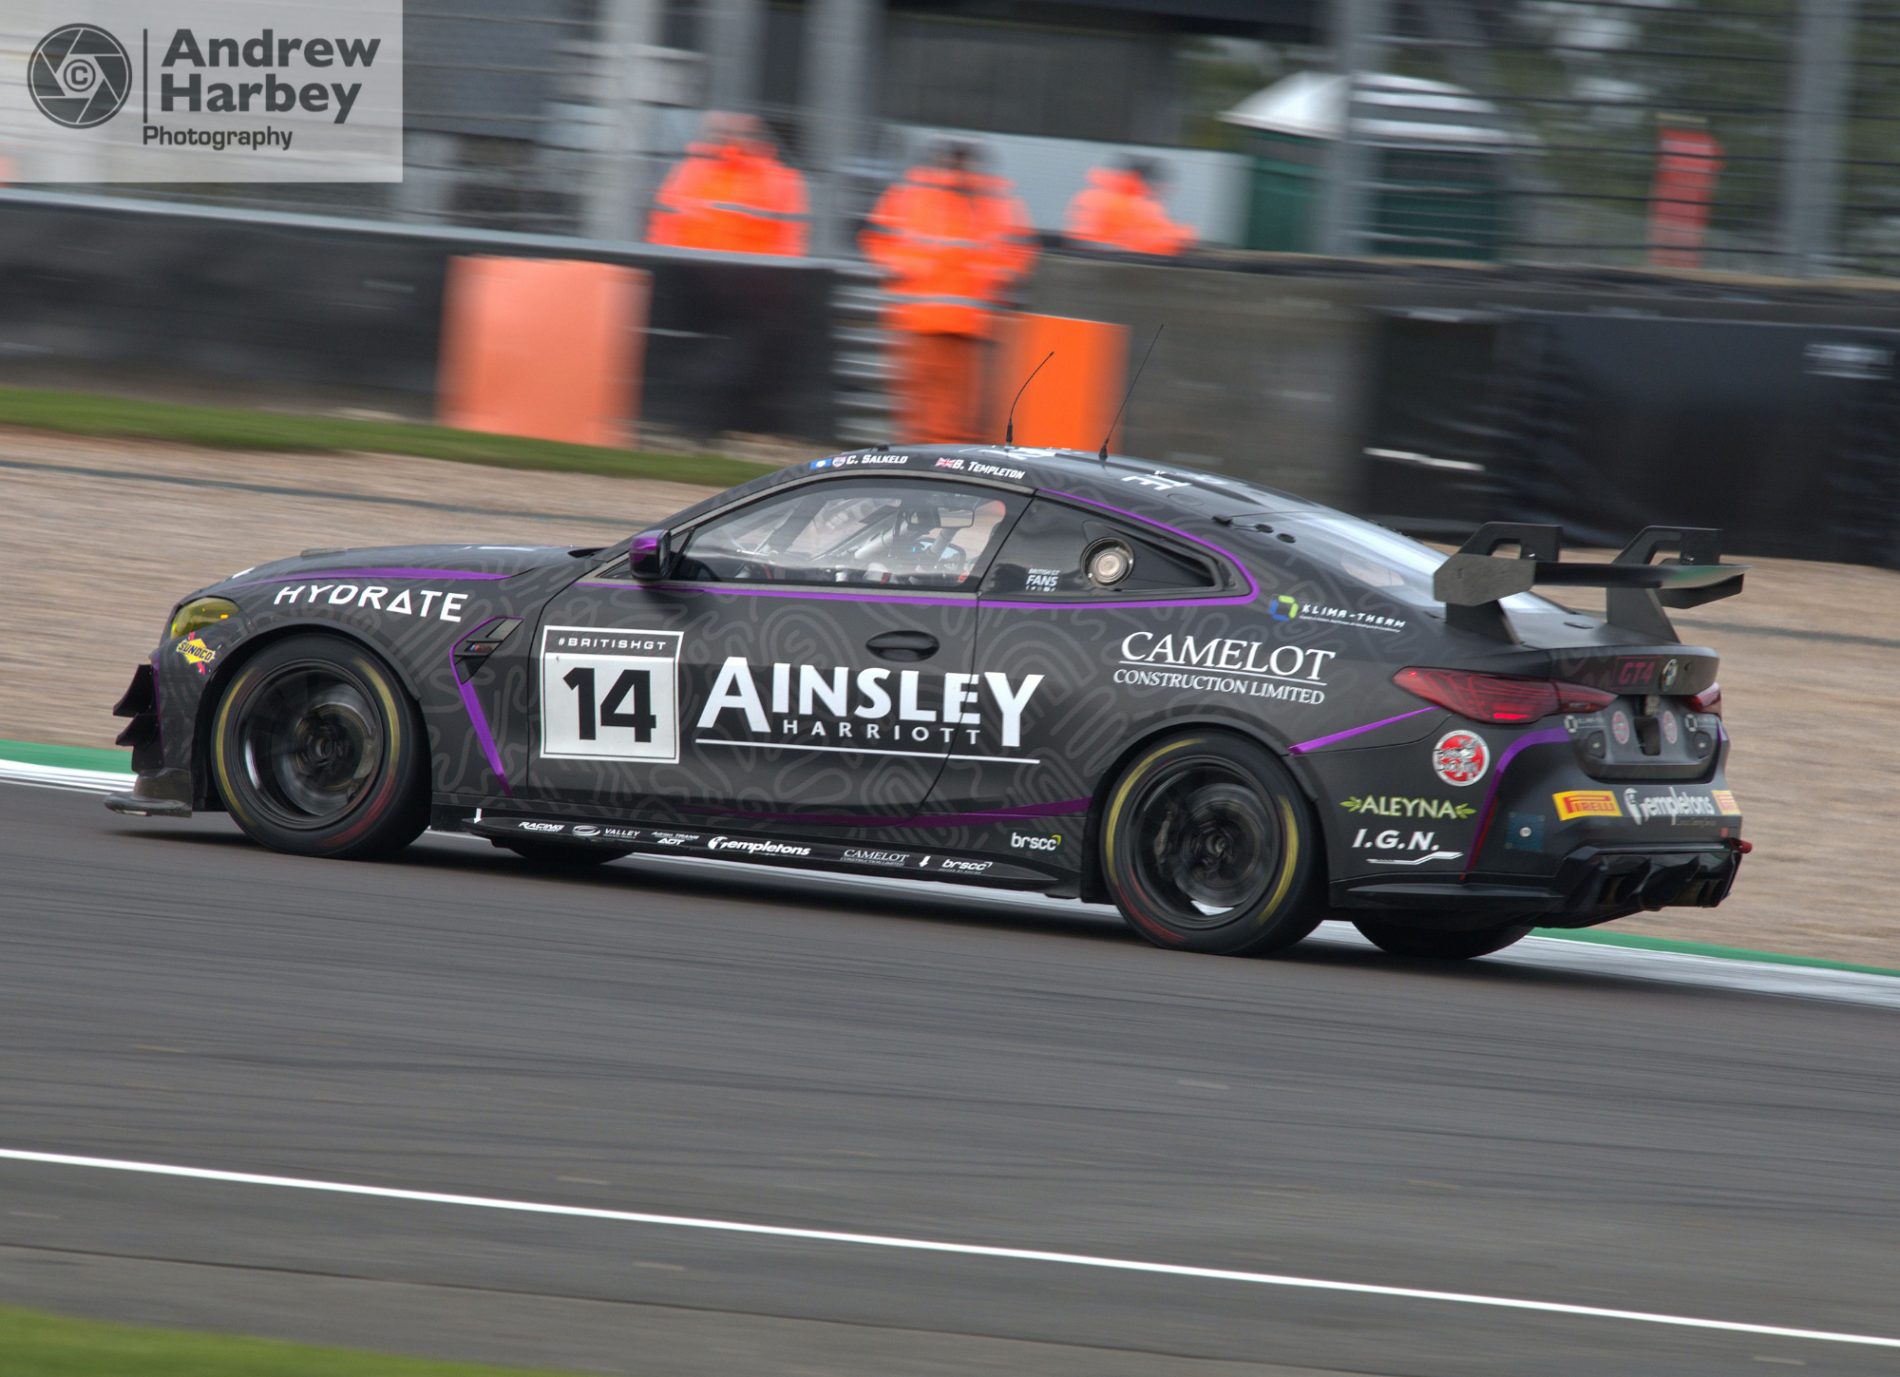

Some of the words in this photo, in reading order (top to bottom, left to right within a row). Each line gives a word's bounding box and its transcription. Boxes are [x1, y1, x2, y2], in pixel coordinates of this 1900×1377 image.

[846, 455, 859, 465] C.
[861, 454, 908, 464] SALKELD
[952, 459, 964, 471] B.
[967, 461, 1025, 480] TEMPLETON
[1026, 575, 1058, 586] FANS
[274, 584, 469, 622] HYDRATE
[177, 640, 215, 662] SUNOCO
[558, 637, 667, 650] #BRITISHGT
[1121, 630, 1336, 681] CAMELOT
[1618, 661, 1657, 685] GT4
[1113, 669, 1247, 694] CONSTRUCTION
[1249, 682, 1325, 705] LIMITED
[562, 666, 656, 743] 14
[697, 656, 1045, 747] AINSLEY
[783, 719, 981, 745] HARRIOTT
[1357, 795, 1458, 819] ALEYNA
[518, 821, 565, 832] RACING
[604, 828, 640, 836] VALLEY
[1011, 832, 1057, 850] brscc
[1352, 829, 1440, 851] I.G.N.
[844, 849, 910, 862] CAMELOT
[942, 859, 986, 871] brscc
